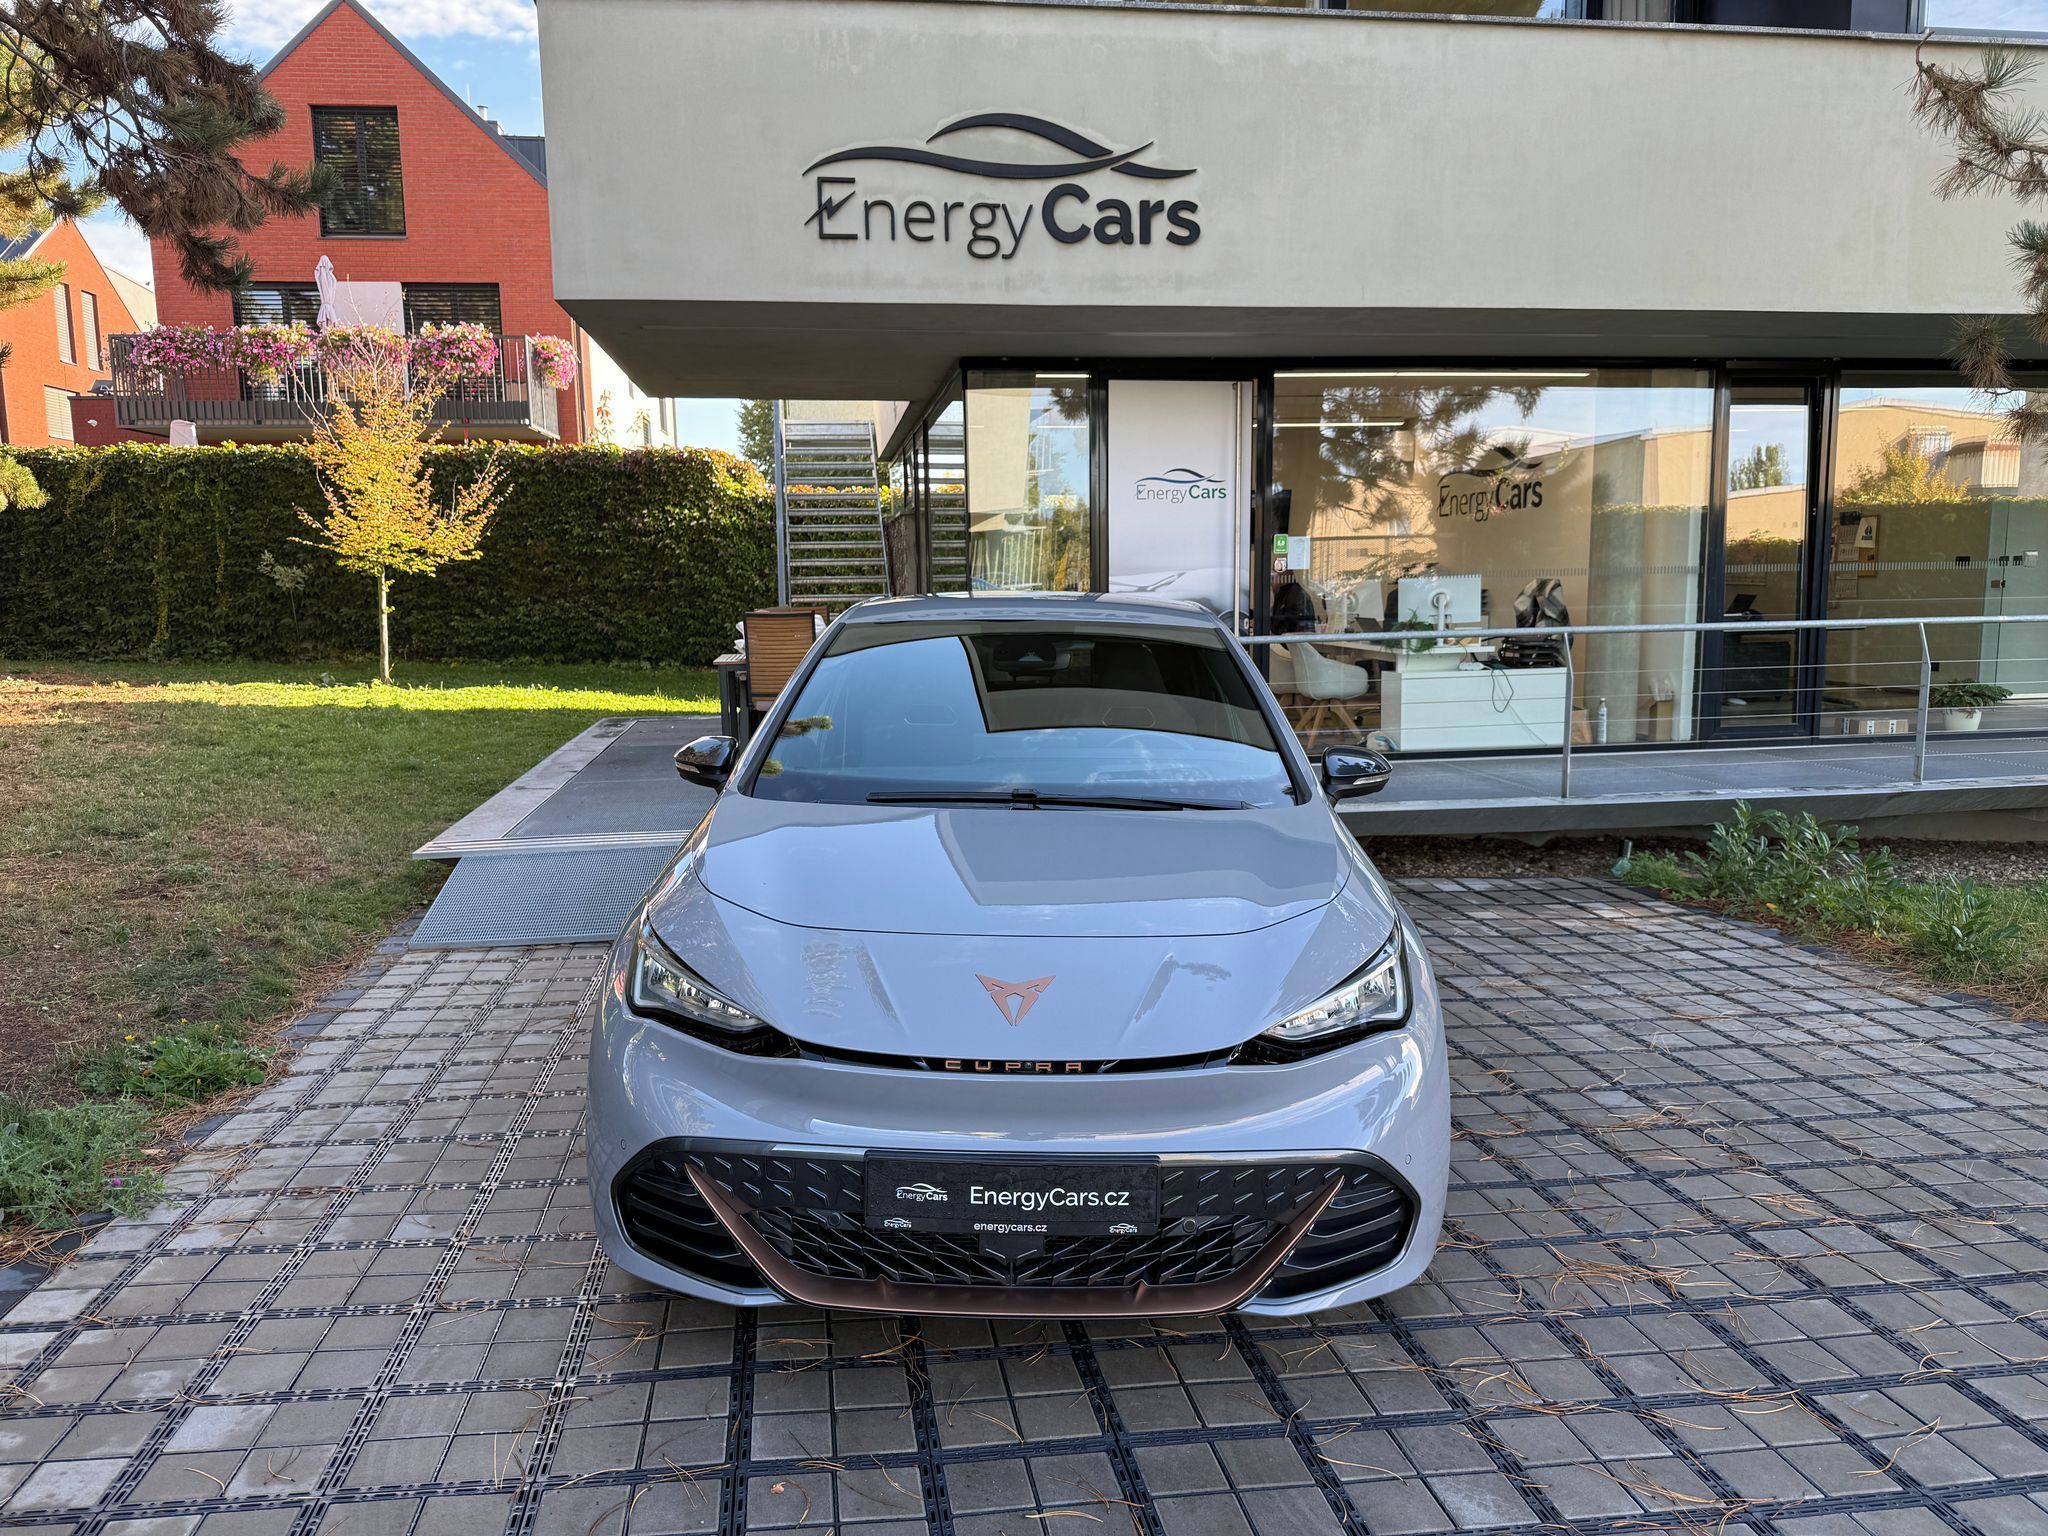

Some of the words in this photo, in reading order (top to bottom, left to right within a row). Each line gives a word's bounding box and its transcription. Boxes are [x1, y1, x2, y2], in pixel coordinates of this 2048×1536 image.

[804, 176, 1201, 260] EnergyCars
[1135, 484, 1227, 504] EnergyCars
[1437, 477, 1543, 522] EnergyCars
[945, 1060, 1083, 1073] CUPRA
[895, 1190, 948, 1202] EnergyCars
[970, 1185, 1130, 1211] EnergyCars.cz
[973, 1222, 1048, 1233] energycars.cz
